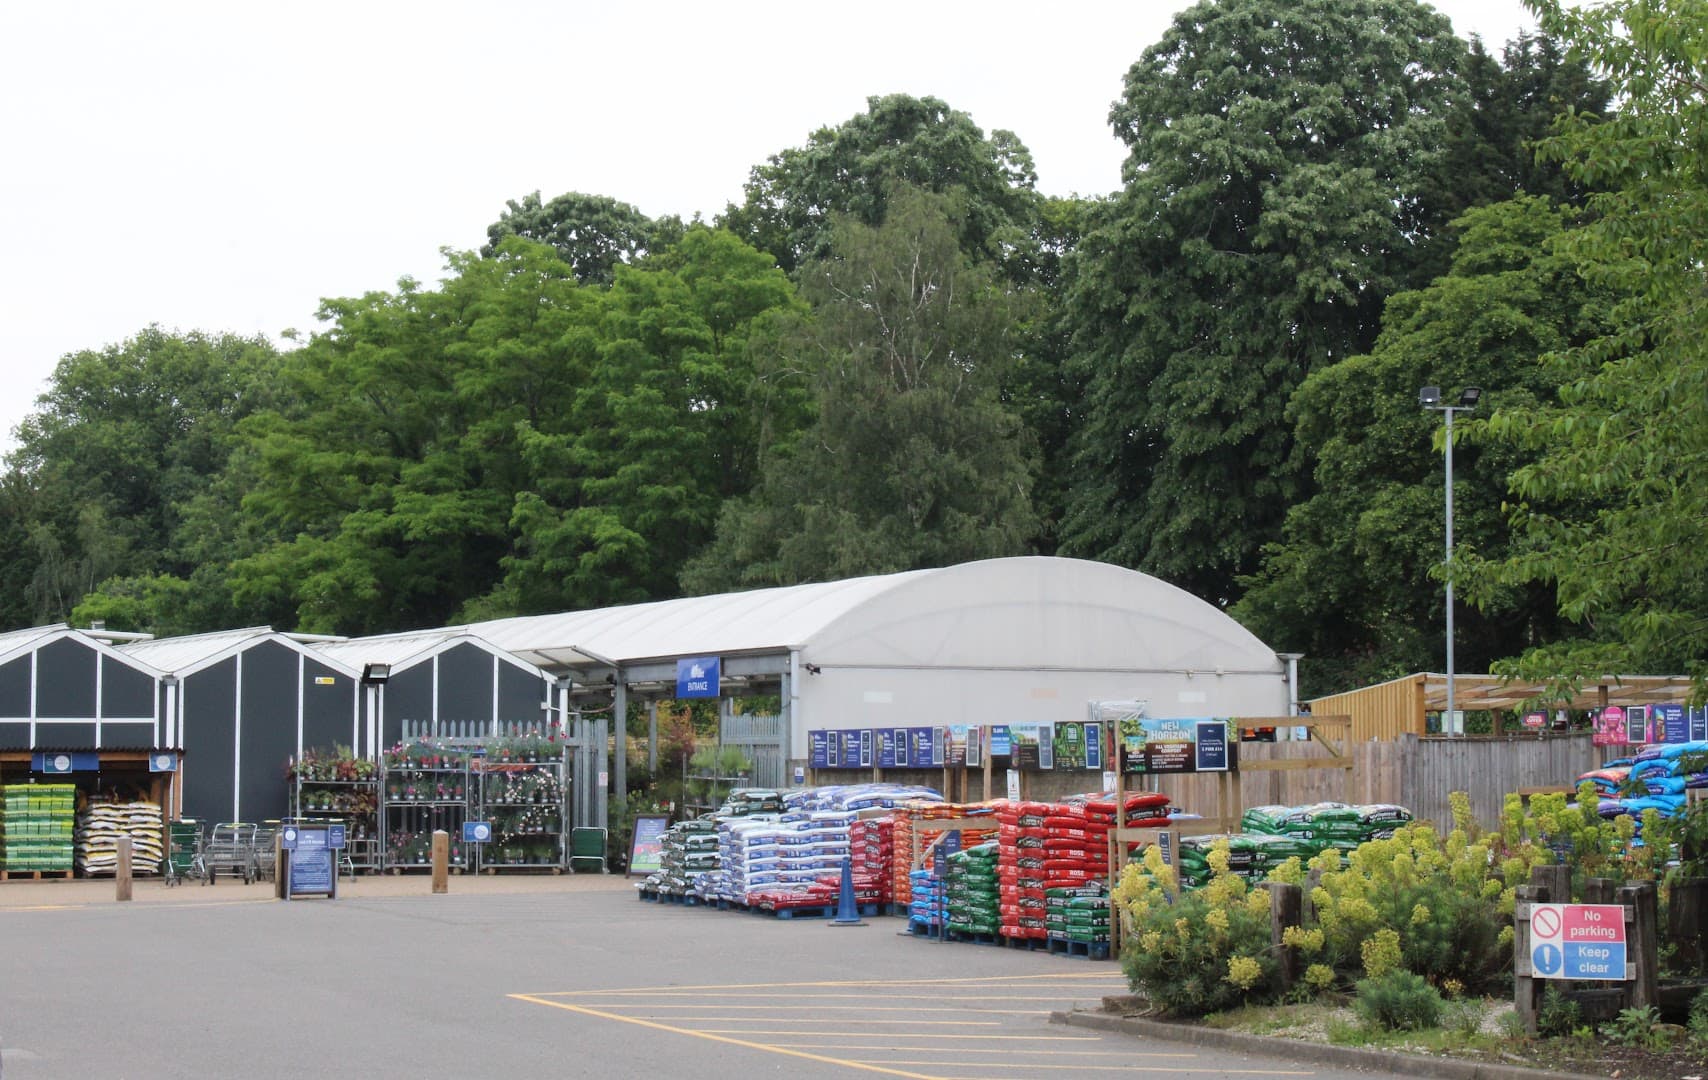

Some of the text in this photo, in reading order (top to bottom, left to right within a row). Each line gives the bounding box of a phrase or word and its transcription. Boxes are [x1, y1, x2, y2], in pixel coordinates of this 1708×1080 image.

[688, 681, 708, 691] ENTRANCE
[1161, 721, 1180, 731] NEW
[1151, 730, 1191, 740] HORIZON
[1584, 911, 1601, 921] No
[1570, 926, 1616, 939] parking
[1578, 946, 1610, 960] Keep
[1579, 962, 1609, 973] clear
